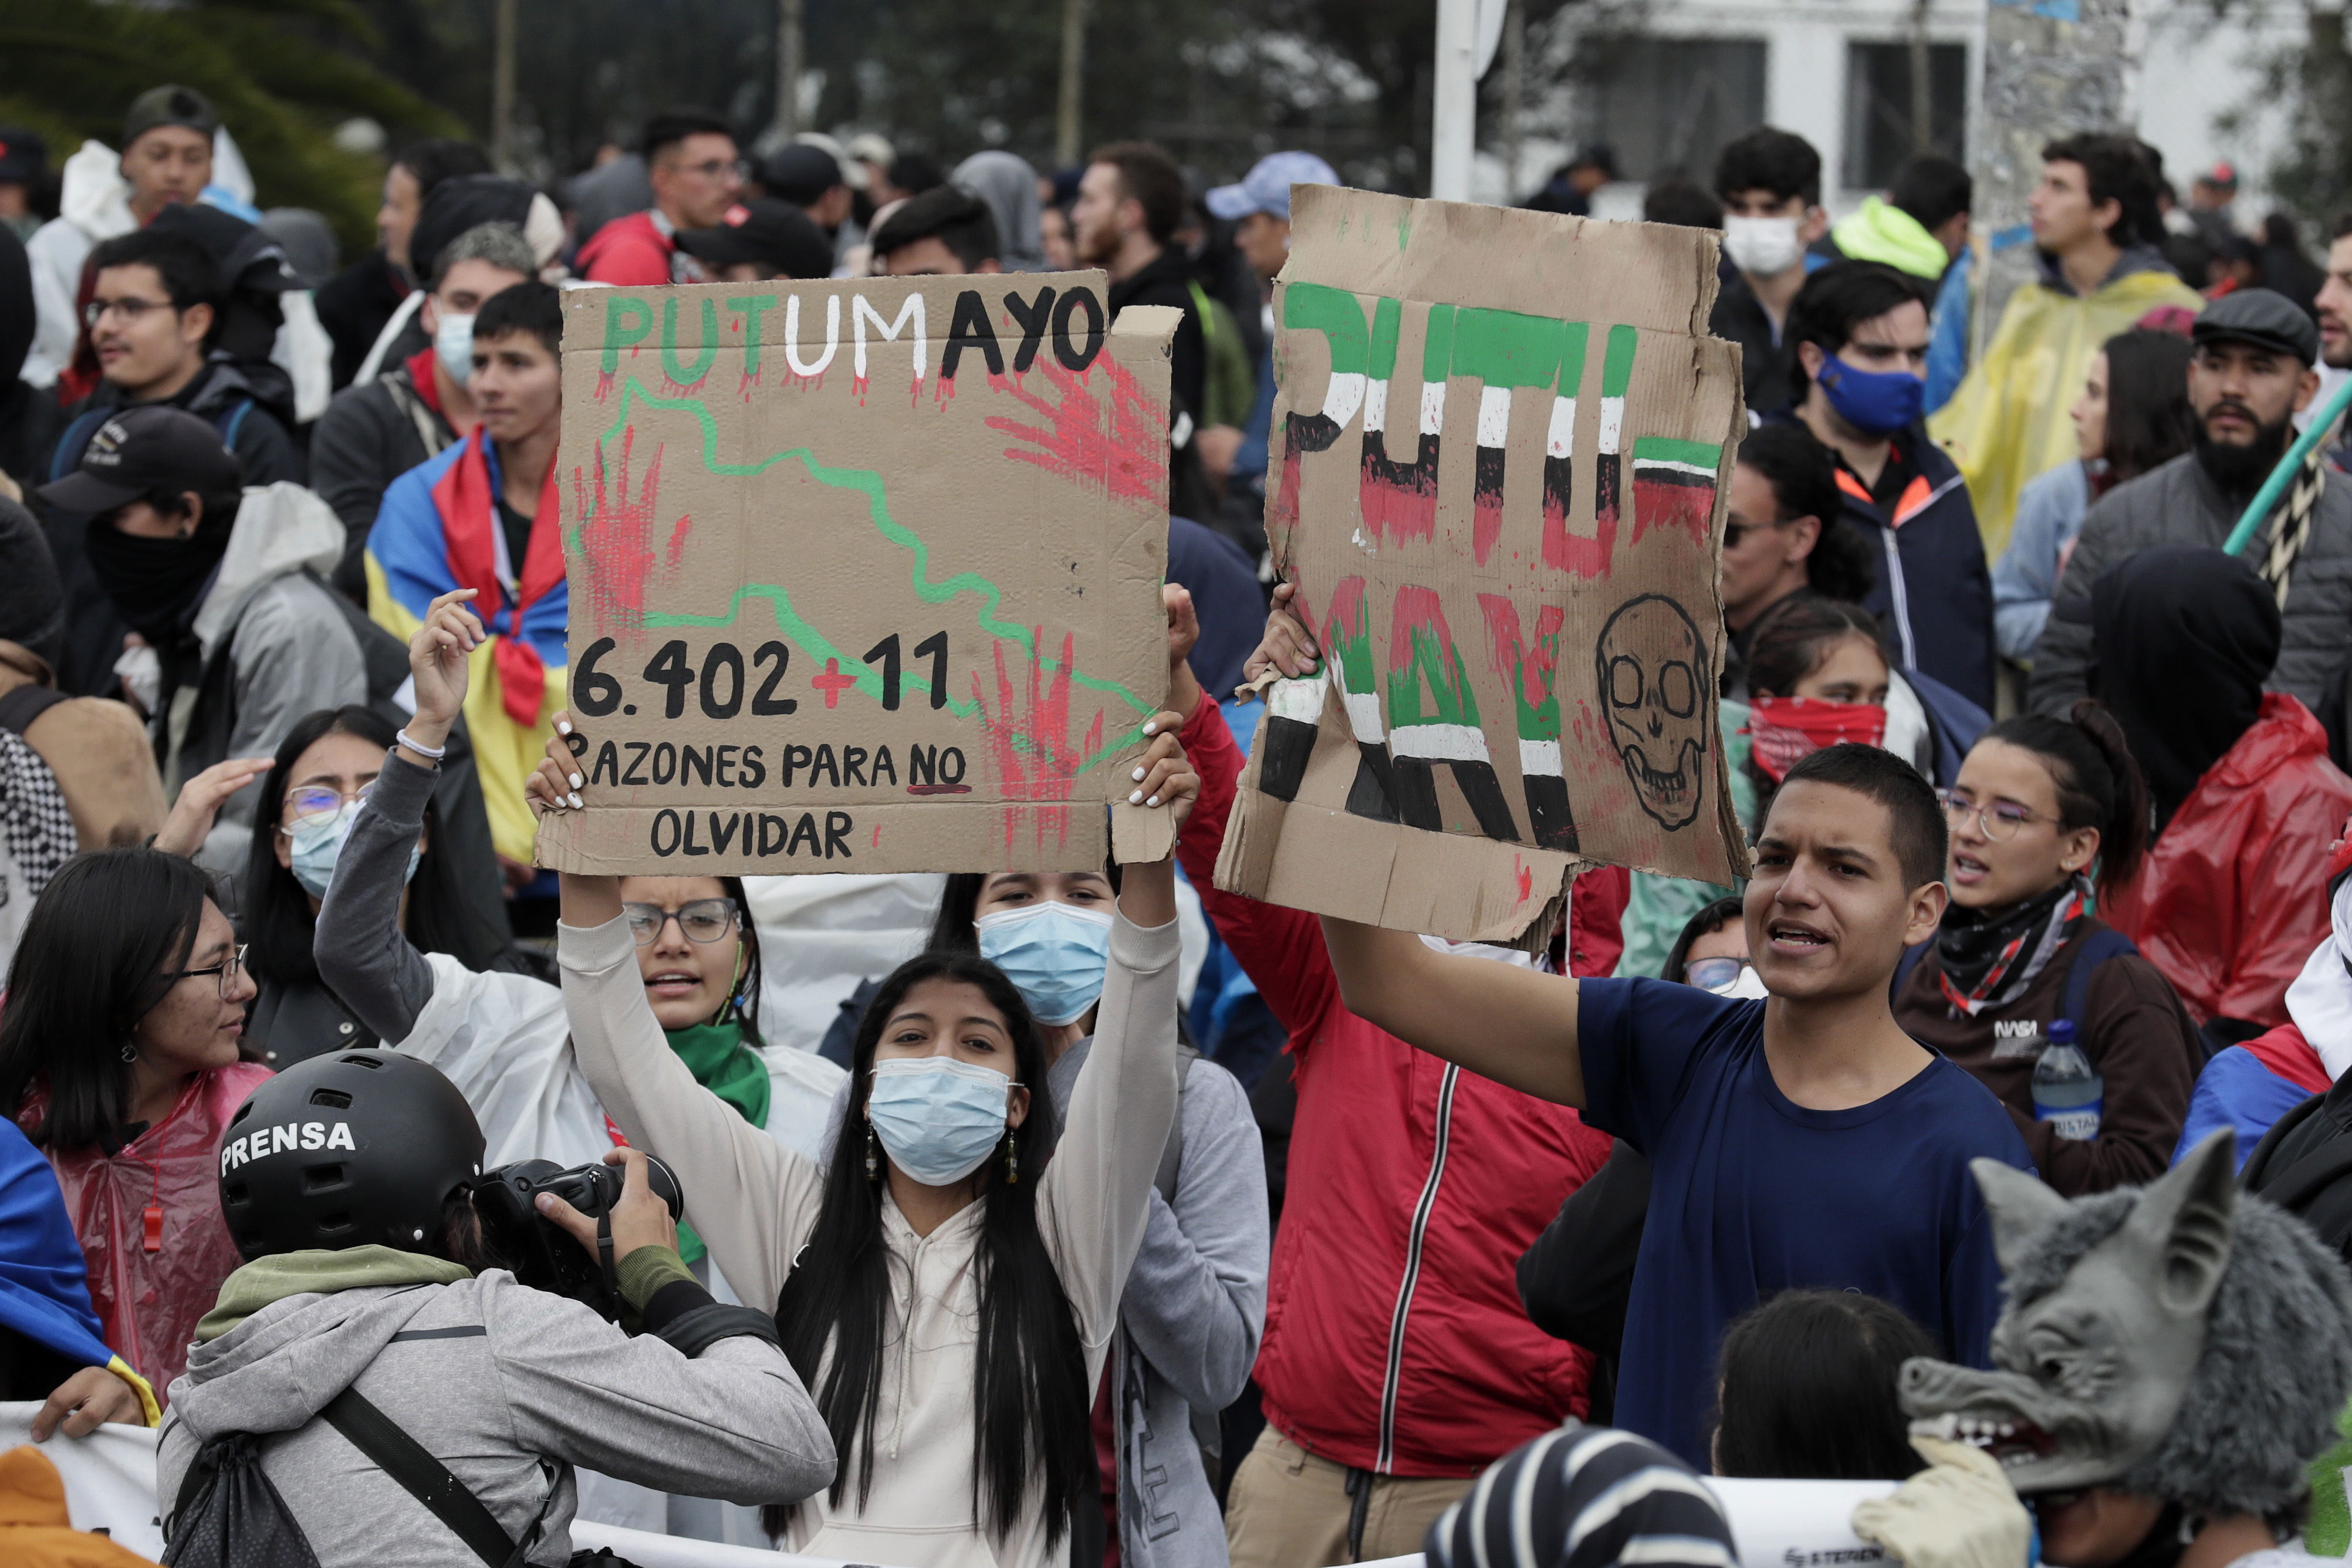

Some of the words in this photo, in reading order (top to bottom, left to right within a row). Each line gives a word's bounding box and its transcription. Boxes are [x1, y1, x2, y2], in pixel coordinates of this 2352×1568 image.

[600, 286, 1104, 387] PUTUMAYO
[782, 743, 898, 788] PARA
[909, 743, 966, 786] NO
[650, 809, 854, 860] OLVIDAR
[1994, 1019, 2038, 1038] NASA
[221, 1121, 356, 1178] PRENSA
